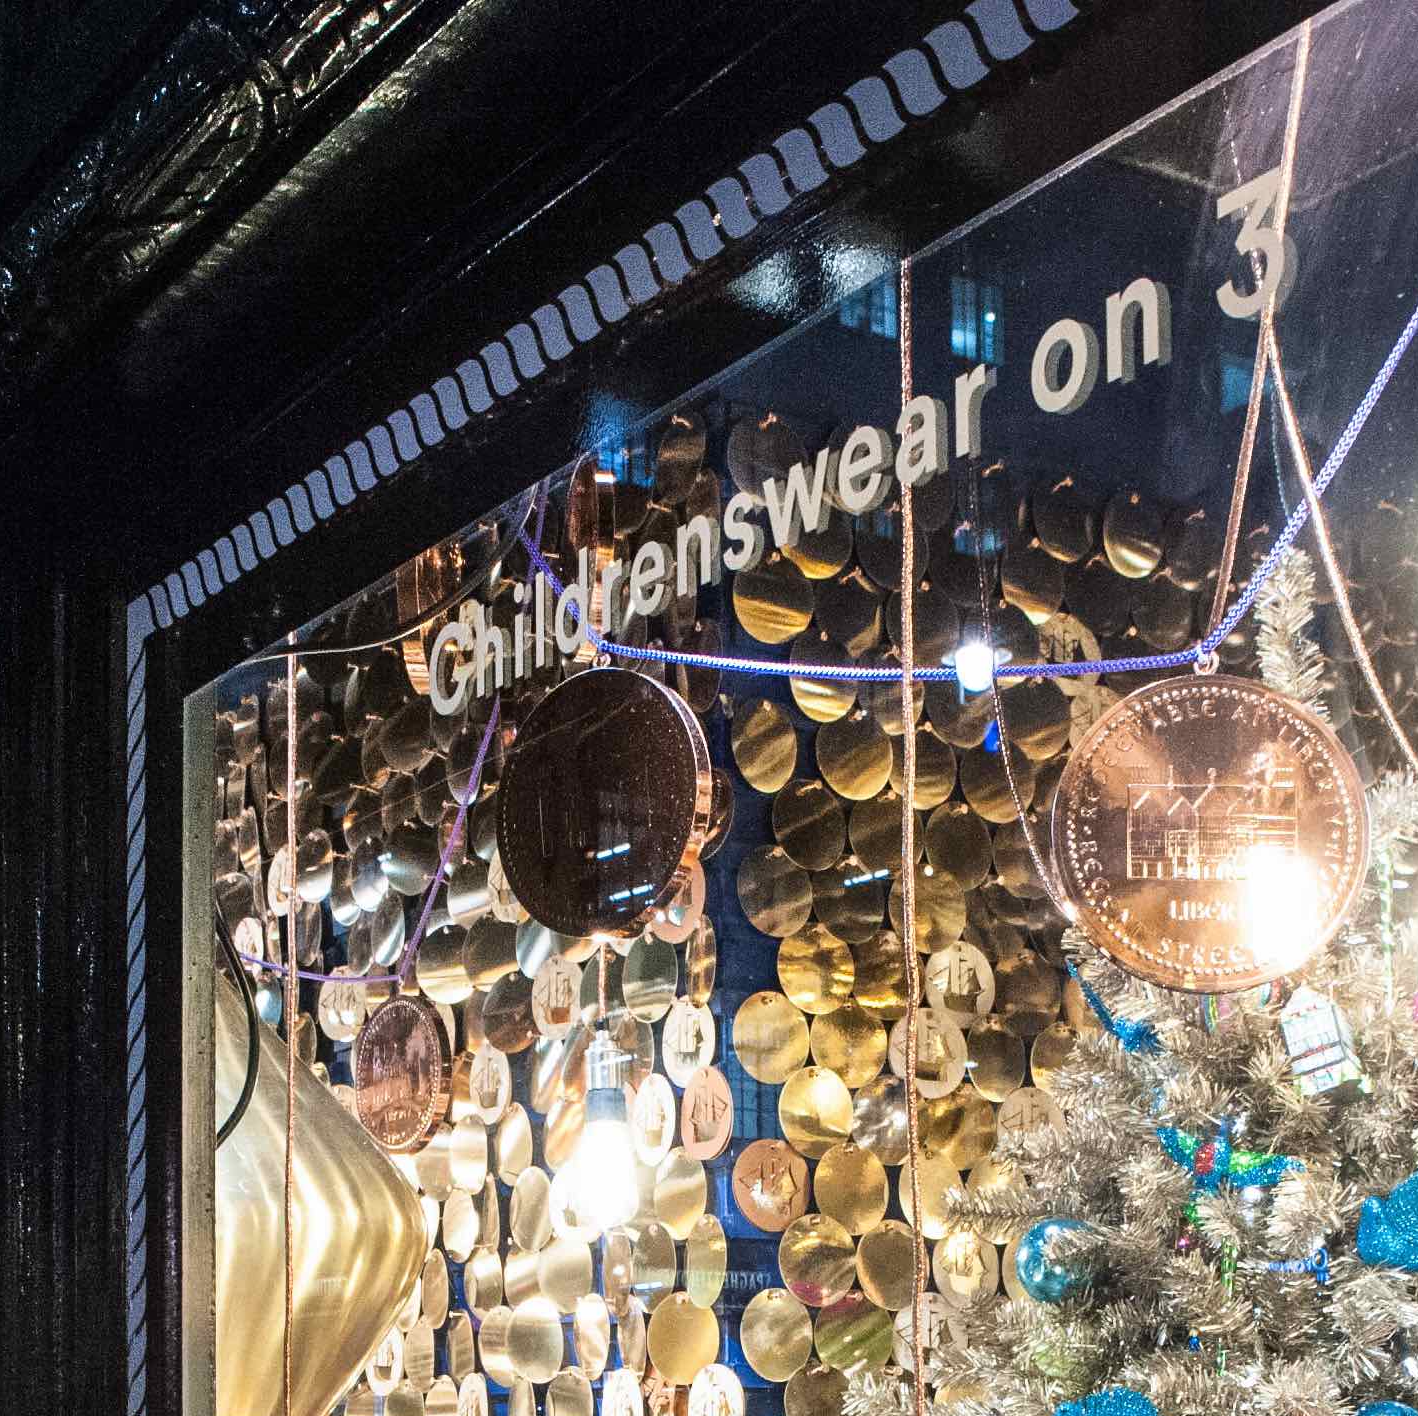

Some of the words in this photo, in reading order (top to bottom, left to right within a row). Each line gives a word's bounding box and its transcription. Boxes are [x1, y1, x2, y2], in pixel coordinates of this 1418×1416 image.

[429, 363, 995, 718] Childrenswear
[1031, 277, 1171, 415] on
[1216, 165, 1291, 321] 3
